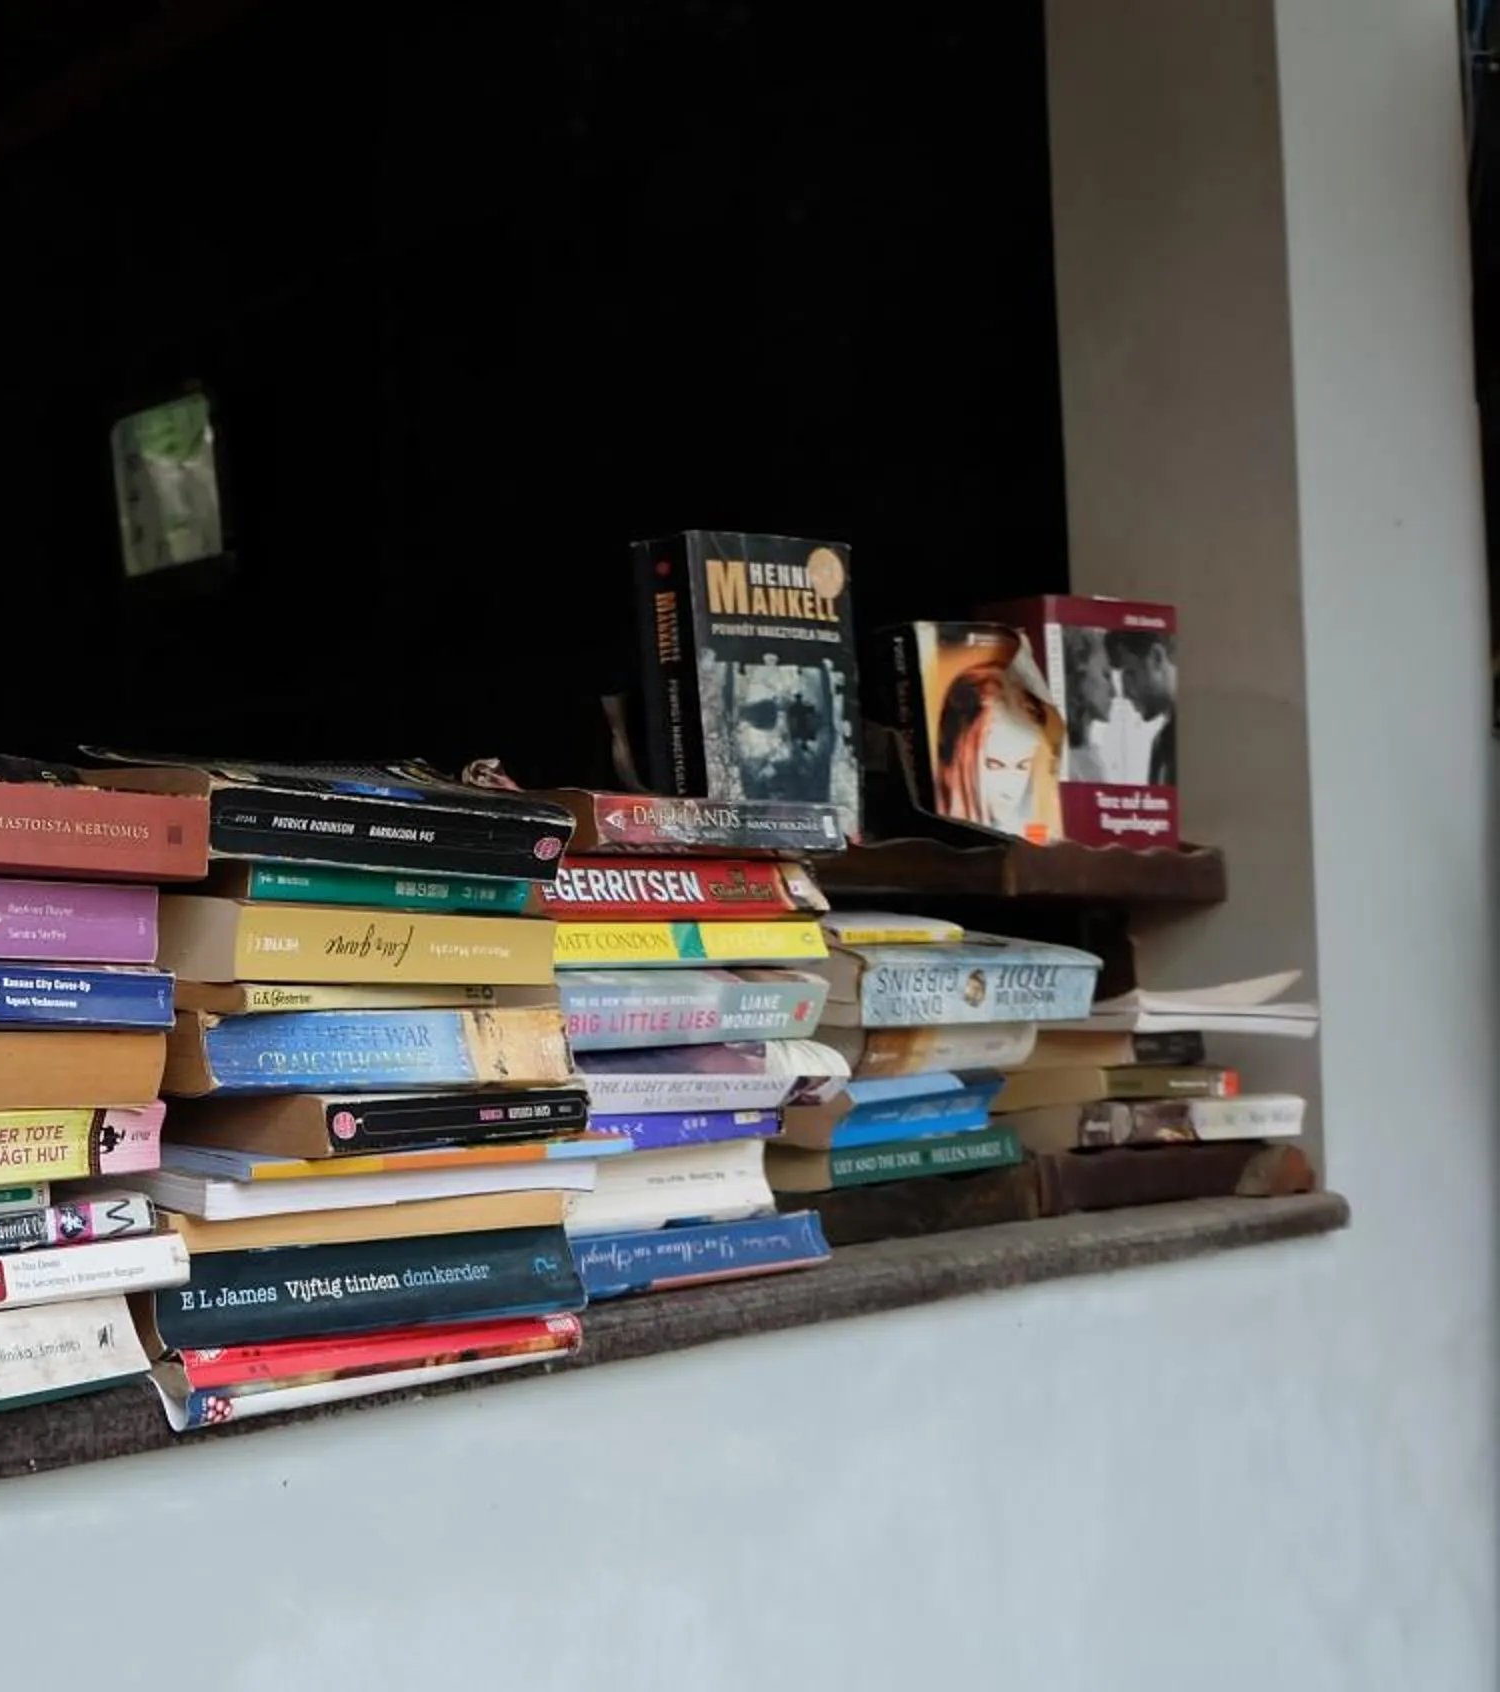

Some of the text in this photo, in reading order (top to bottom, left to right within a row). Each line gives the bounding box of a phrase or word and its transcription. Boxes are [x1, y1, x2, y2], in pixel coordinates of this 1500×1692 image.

[750, 563, 812, 588] HENNI
[75, 822, 150, 839] KERTOMUS
[272, 815, 307, 832] PATRICK
[309, 819, 355, 836] ROBINSON
[556, 868, 706, 903] GERRITSEN
[595, 932, 671, 949] CONDON
[876, 966, 961, 993] GIBBINS
[740, 993, 782, 1012] LIANE
[568, 1010, 719, 1035] BIG LITTLE LIES
[722, 1012, 790, 1030] MORIARTY
[385, 1025, 433, 1050] WAR
[592, 1080, 621, 1095] THE
[26, 1125, 65, 1141] TOTE
[37, 1145, 69, 1163] HUT
[181, 1263, 491, 1311] E L James Vijftig tinten donkerder
